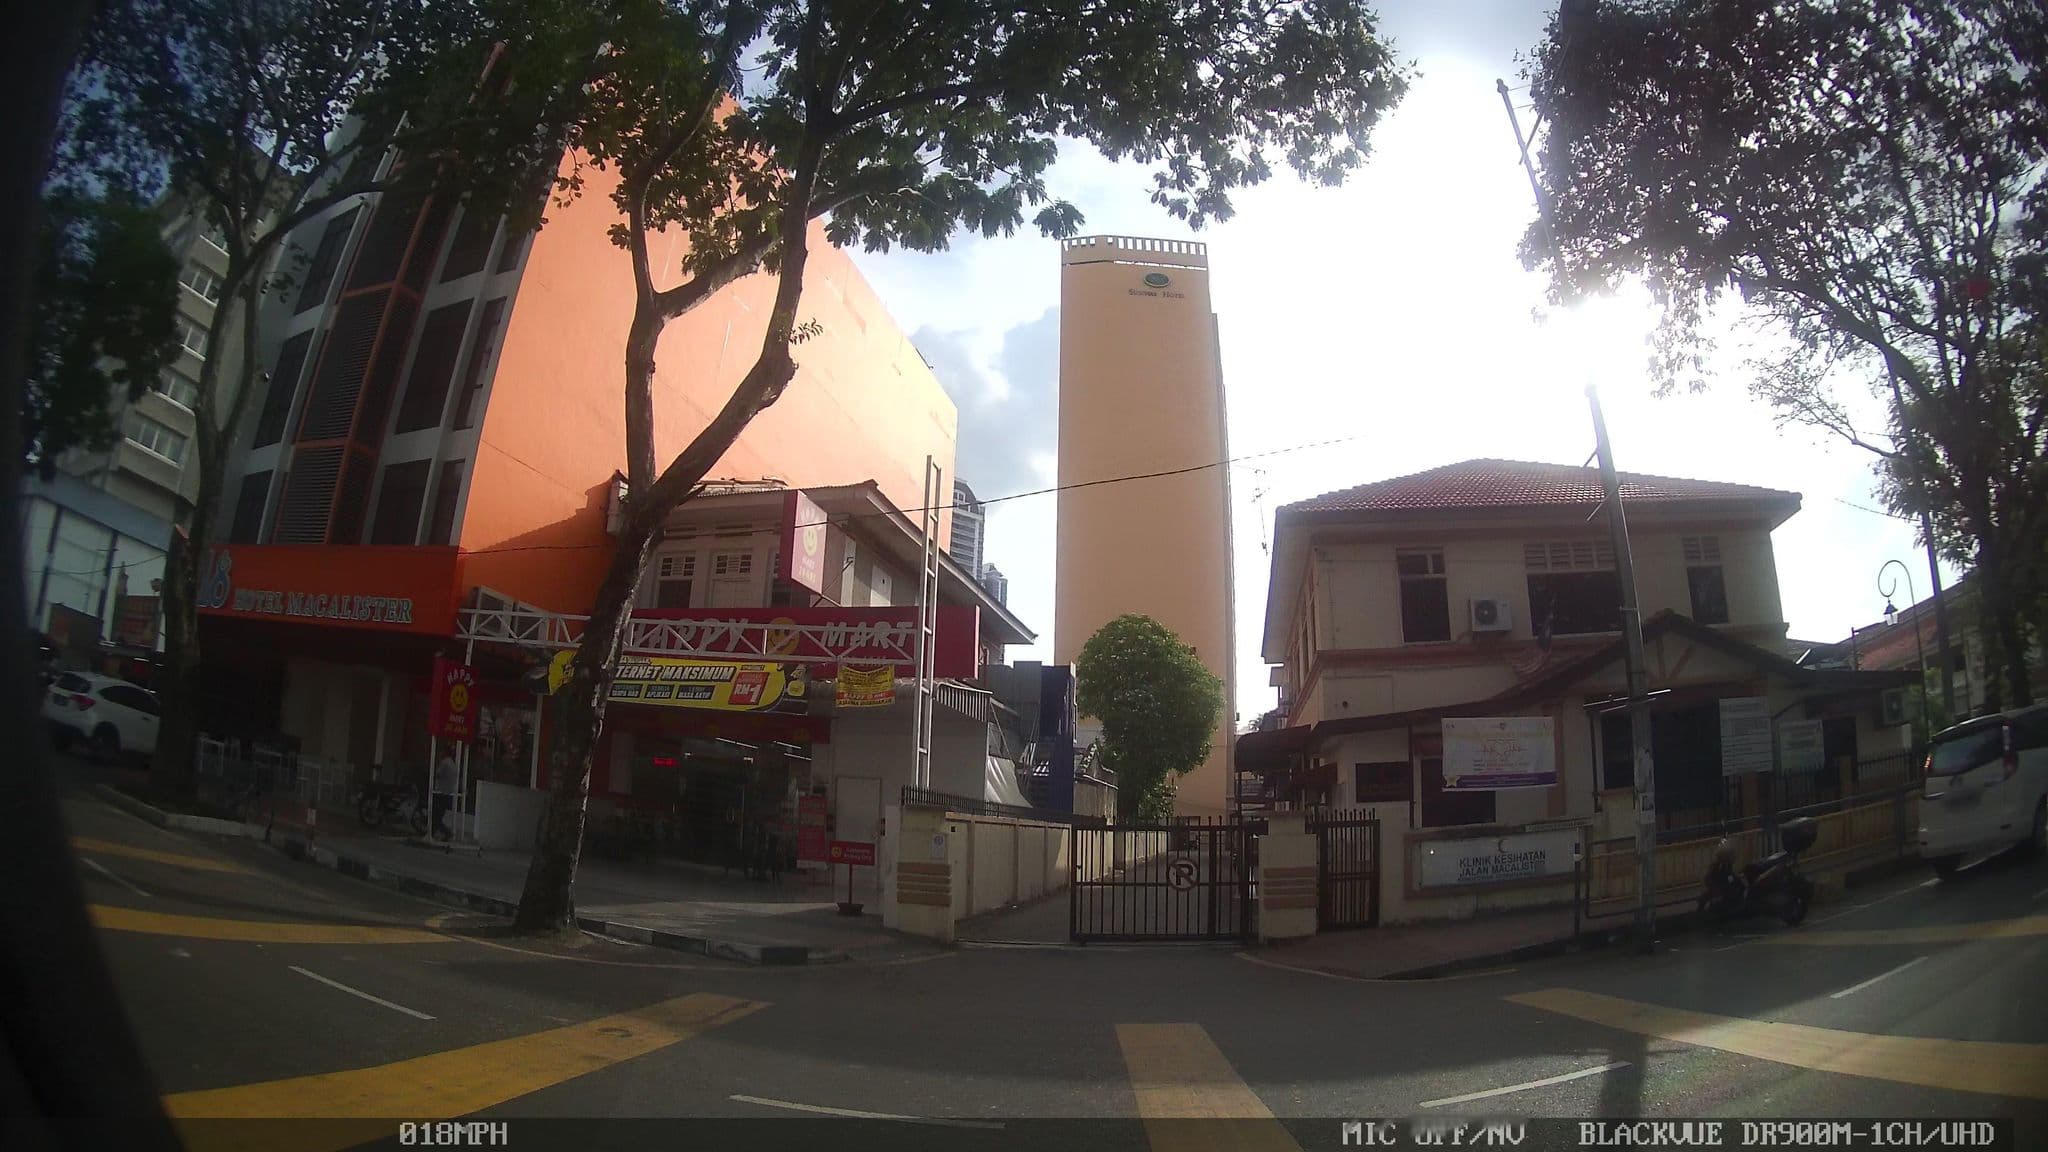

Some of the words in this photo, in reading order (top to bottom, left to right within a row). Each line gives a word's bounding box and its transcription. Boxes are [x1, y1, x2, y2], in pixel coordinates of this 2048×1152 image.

[286, 591, 413, 624] MACALISTER
[819, 620, 914, 650] MART
[661, 666, 736, 682] MAKSIMUM
[1459, 855, 1492, 868] KLINIK
[1494, 849, 1547, 865] KESIHATAN
[1459, 865, 1489, 879] JALAN
